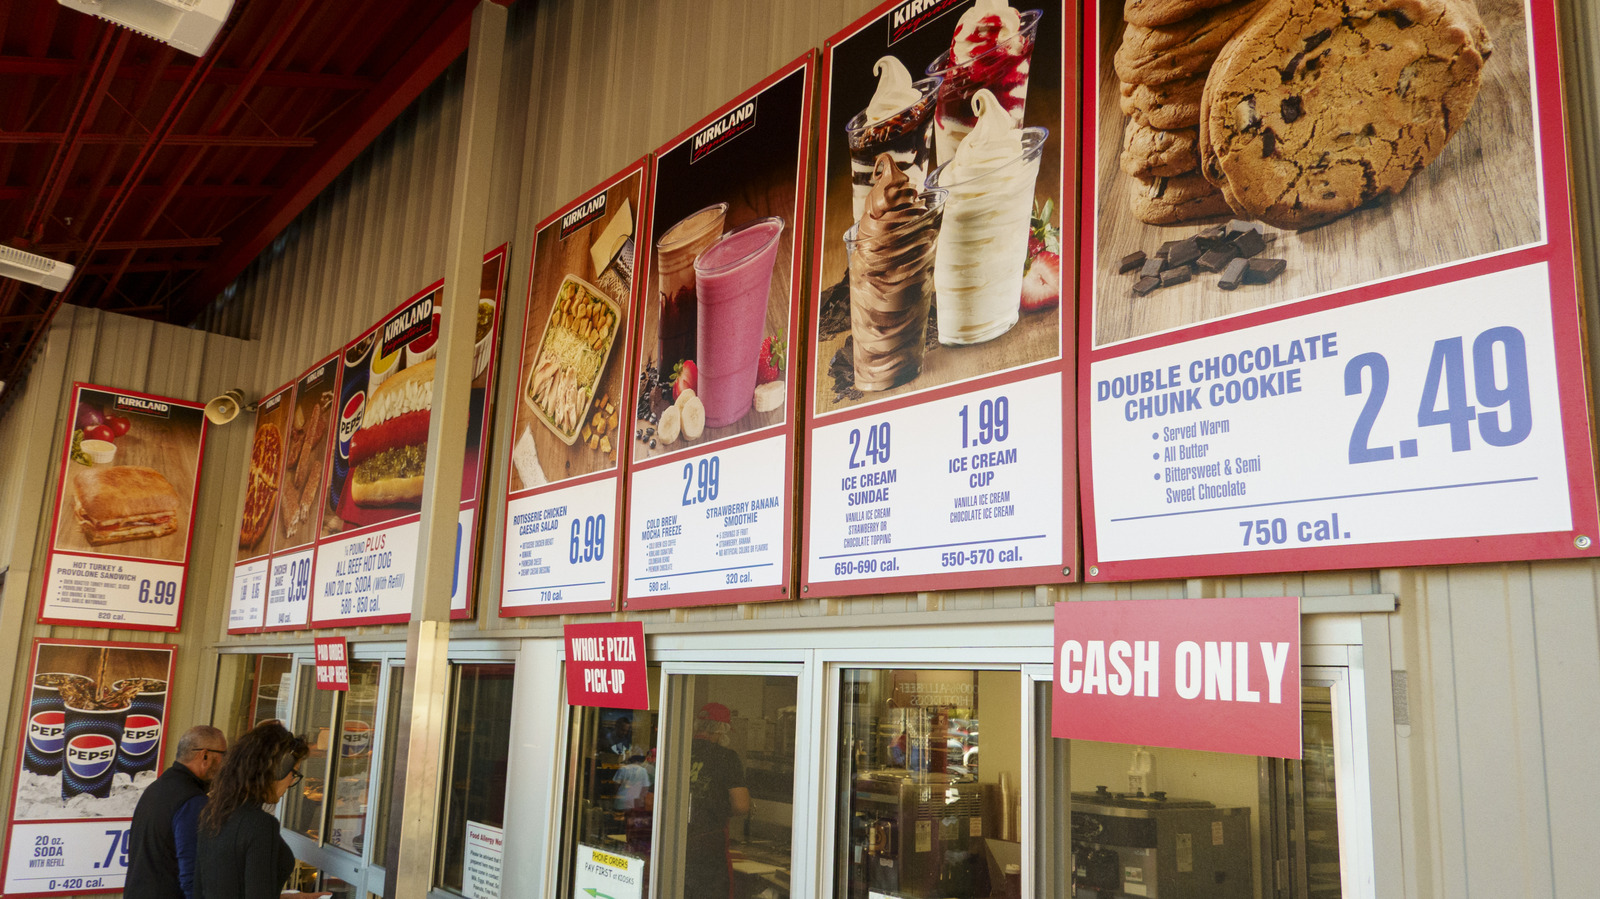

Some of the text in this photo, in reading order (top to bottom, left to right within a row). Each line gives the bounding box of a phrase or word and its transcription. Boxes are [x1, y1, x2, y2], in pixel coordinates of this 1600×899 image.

[893, 0, 941, 28] KIRK
[695, 102, 754, 150] KIRKLAND
[694, 120, 752, 160] Signature
[563, 195, 606, 230] KIRKLAND
[384, 299, 432, 343] KIRKLAND
[1097, 332, 1338, 402] DOUBLE CHOCOLATE
[118, 397, 168, 412] KIRKLAND
[1125, 368, 1302, 422] CHUNK COOKIE
[1344, 325, 1533, 465] 2.49
[958, 396, 1009, 448] 1.99
[1163, 419, 1230, 442] Served Warm
[848, 421, 891, 470] 2.49
[1164, 444, 1209, 462] All Butter
[949, 448, 1017, 473] ICE CREAM
[1165, 455, 1261, 483] Bittersweet & Semi
[682, 456, 720, 506] 2.99
[841, 468, 897, 491] ICE CREAM
[970, 471, 994, 488] CUP
[848, 487, 889, 506] SUNDAE
[954, 491, 1010, 508] VANILLA ICE CREAM
[1166, 480, 1246, 504] Sweet Chocolate
[513, 505, 567, 526] ROTISSERIE CHICKEN
[706, 496, 779, 519] STRAWBERRY BANANA
[846, 511, 864, 522] VANILLA
[874, 507, 890, 519] CREAM
[950, 505, 1014, 523] CHOCOLATE ICE CREAM
[519, 519, 558, 536] CAESAR SALAD
[647, 515, 678, 529] COLD BREW
[724, 512, 757, 527] SMOOTHIE
[848, 521, 887, 535] STRAWBERRY OR
[570, 513, 606, 565] 6.99
[642, 525, 682, 540] MOCHA FREEZE
[1239, 512, 1351, 547] 750 cal.
[365, 534, 386, 552] PLUS
[844, 533, 891, 548] CHOCOLATE TOPPING
[336, 551, 392, 576] ALL BEEF HOT DOG
[941, 546, 1023, 567] 550-570 cal.
[57, 568, 136, 581] PROVOLONE SANDWICH
[89, 563, 116, 572] TURKEY
[834, 557, 900, 576] 650-690 cal.
[288, 557, 310, 602] 3.99
[324, 581, 336, 597] AND
[336, 580, 344, 595] 20
[355, 576, 371, 593] SODA
[649, 580, 670, 592] 580 cal.
[726, 572, 752, 584] 320 cal.
[138, 579, 177, 605] 6.99
[541, 590, 562, 602] 710 cal.
[341, 598, 352, 614] 580
[357, 596, 368, 613] 850
[369, 594, 380, 612] cal.
[572, 637, 636, 661] WHOLE PIZZA
[335, 666, 348, 683] HERE
[584, 668, 625, 694] PICK-UP
[1060, 640, 1290, 704] CASH ONLY
[31, 724, 65, 737] PEP
[122, 728, 158, 740] EPSI
[69, 748, 113, 760] PEPSI
[35, 835, 49, 846] 20
[470, 831, 494, 845] Food Allergy
[34, 847, 63, 857] SODA
[593, 851, 628, 869] PHONE ORDERS
[29, 858, 64, 868] WITH REFILL
[585, 862, 594, 872] PAY
[595, 865, 612, 877] FIRST
[86, 877, 104, 887] cal.
